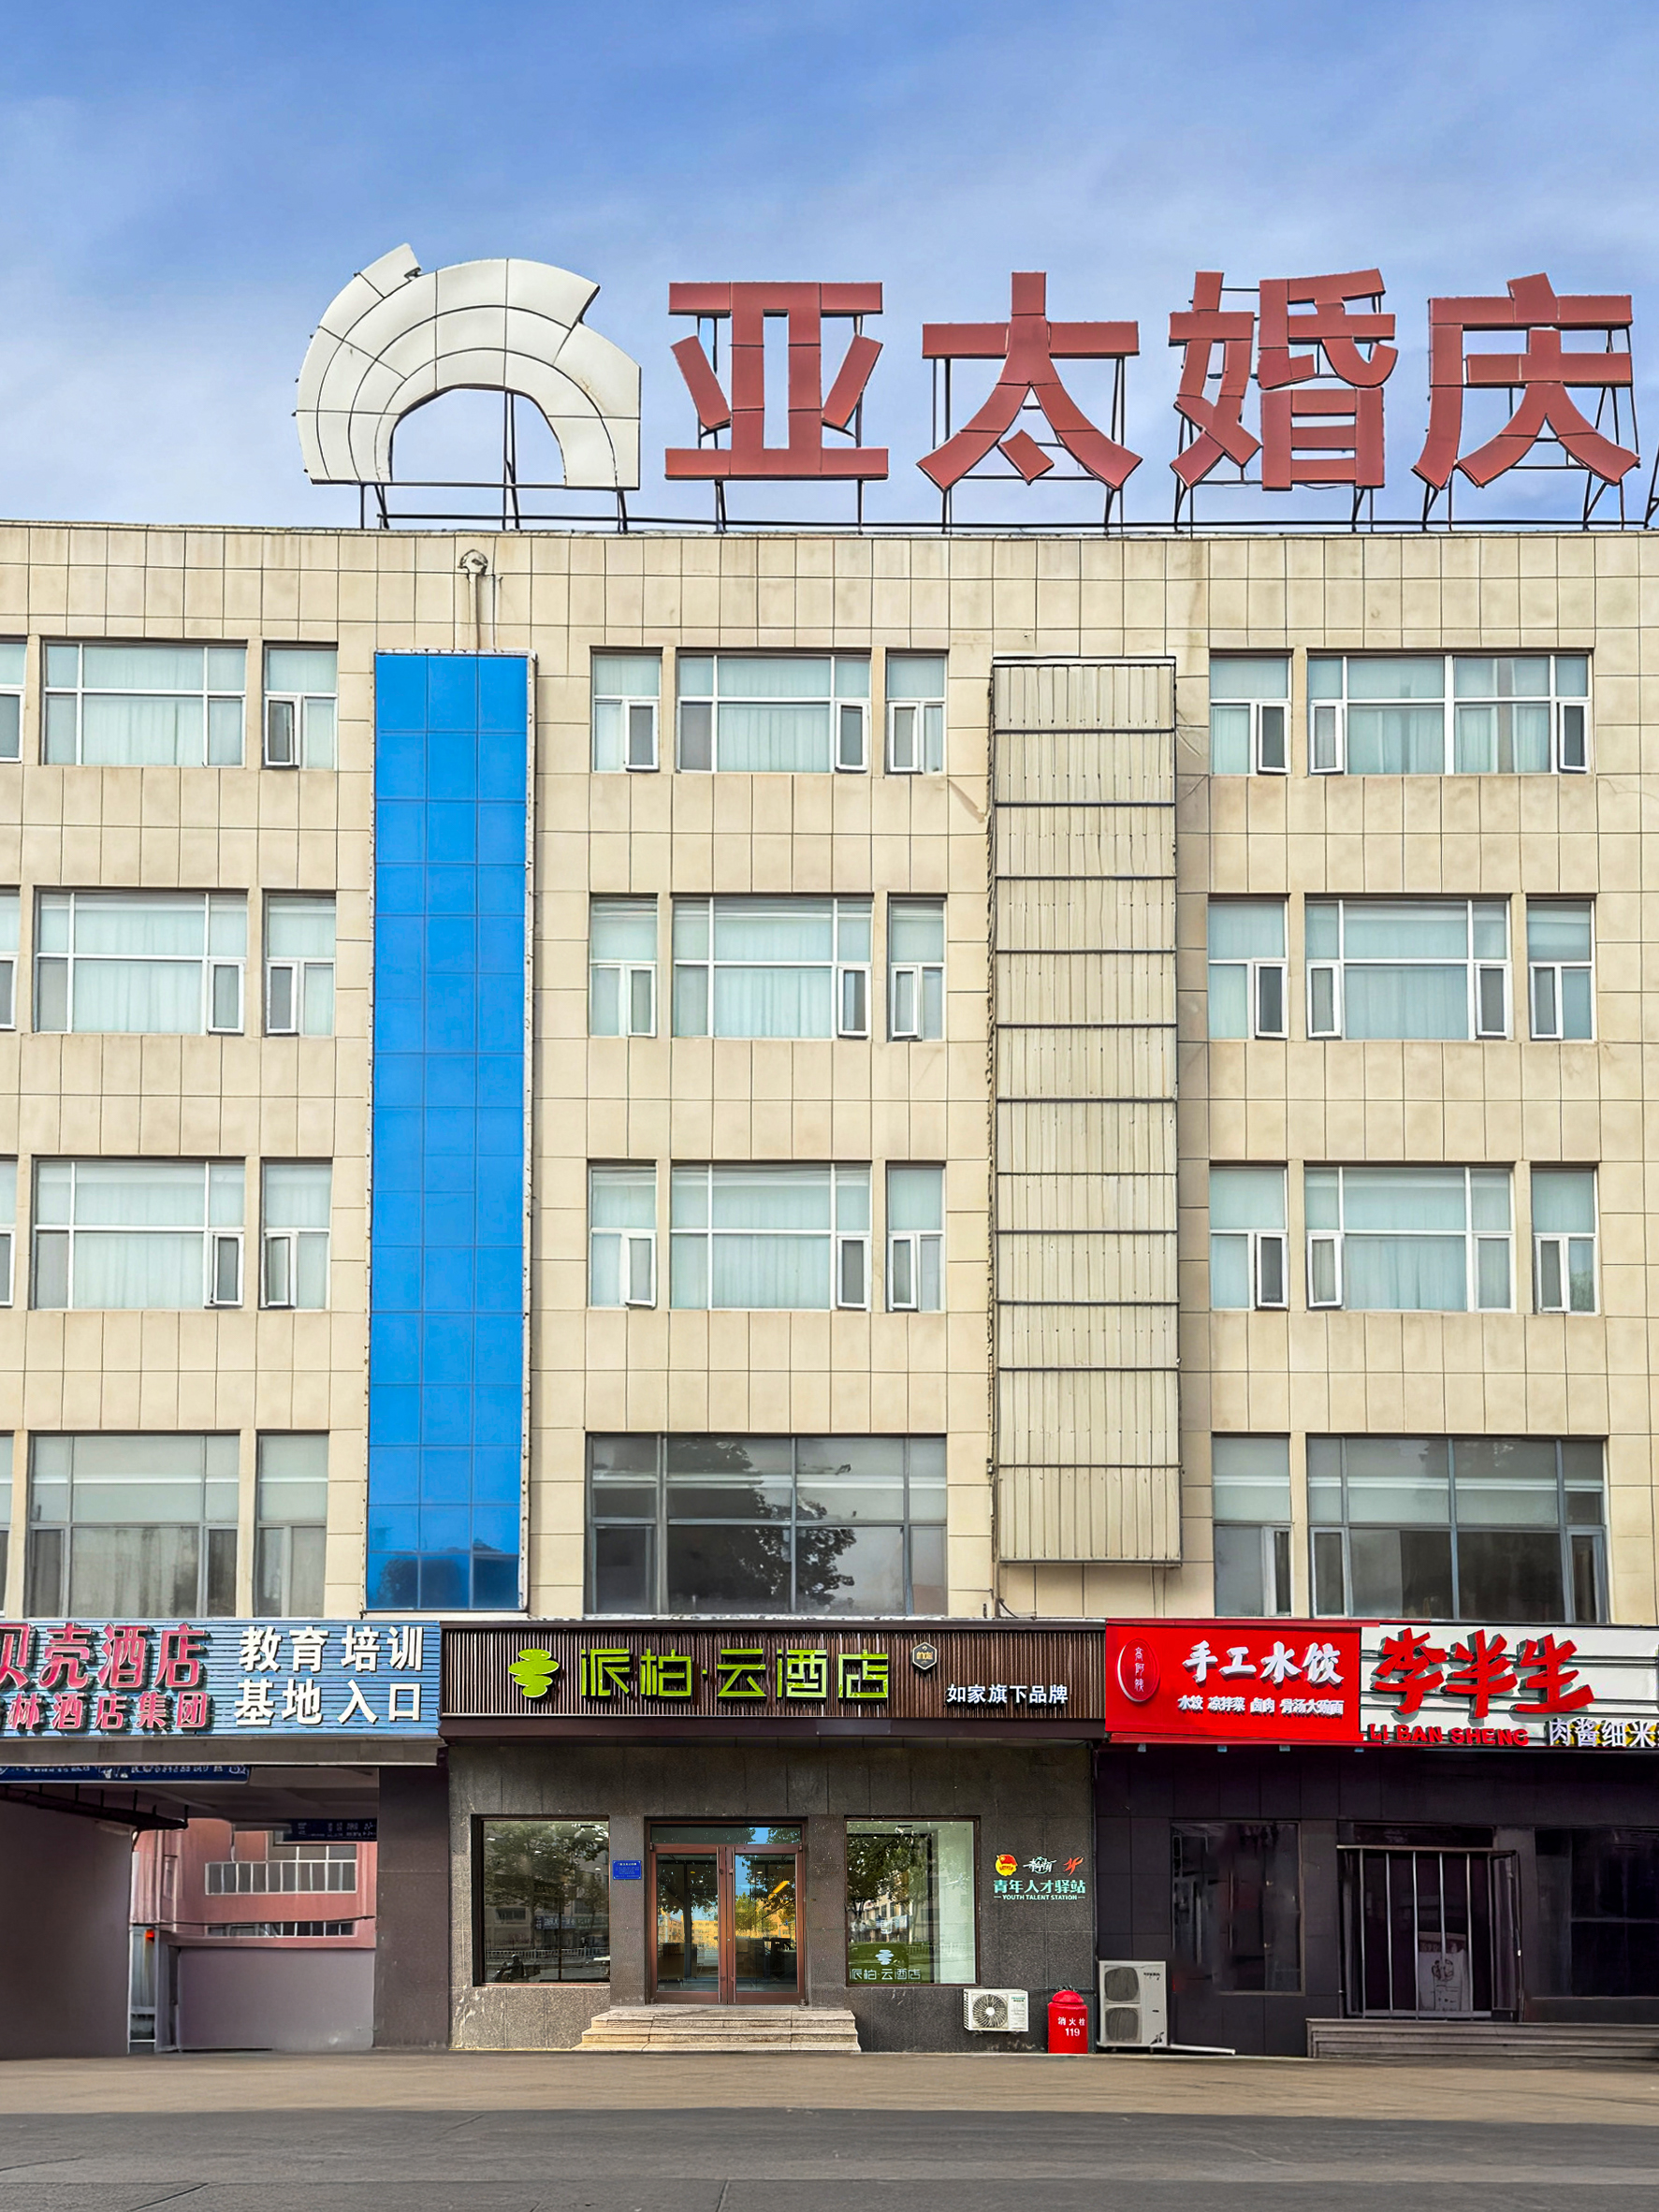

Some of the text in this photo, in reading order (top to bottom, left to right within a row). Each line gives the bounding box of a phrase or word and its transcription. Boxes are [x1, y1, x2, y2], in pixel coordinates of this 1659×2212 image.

[665, 269, 1641, 490] 亚太婚庆
[0, 1623, 205, 1689] 贝壳酒店
[239, 1625, 424, 1672] 教育培训
[1182, 1640, 1345, 1684] 手工水饺
[1372, 1626, 1595, 1719] 李半生
[7, 1691, 208, 1729] 林酒店集团
[234, 1679, 421, 1725] 基地入口
[946, 1683, 1069, 1705] 如家旗下品牌
[1177, 1695, 1204, 1711] 水饺
[1207, 1695, 1246, 1713] 凉拌菜
[1249, 1697, 1275, 1714] 卤肉
[1368, 1724, 1530, 1747] LI BAN SHENG
[1549, 1718, 1659, 1748] 肉酱细米
[993, 1879, 1086, 1894] 青年人才驿站
[1057, 2016, 1085, 2027] 消火栓
[1065, 2028, 1081, 2037] 119
